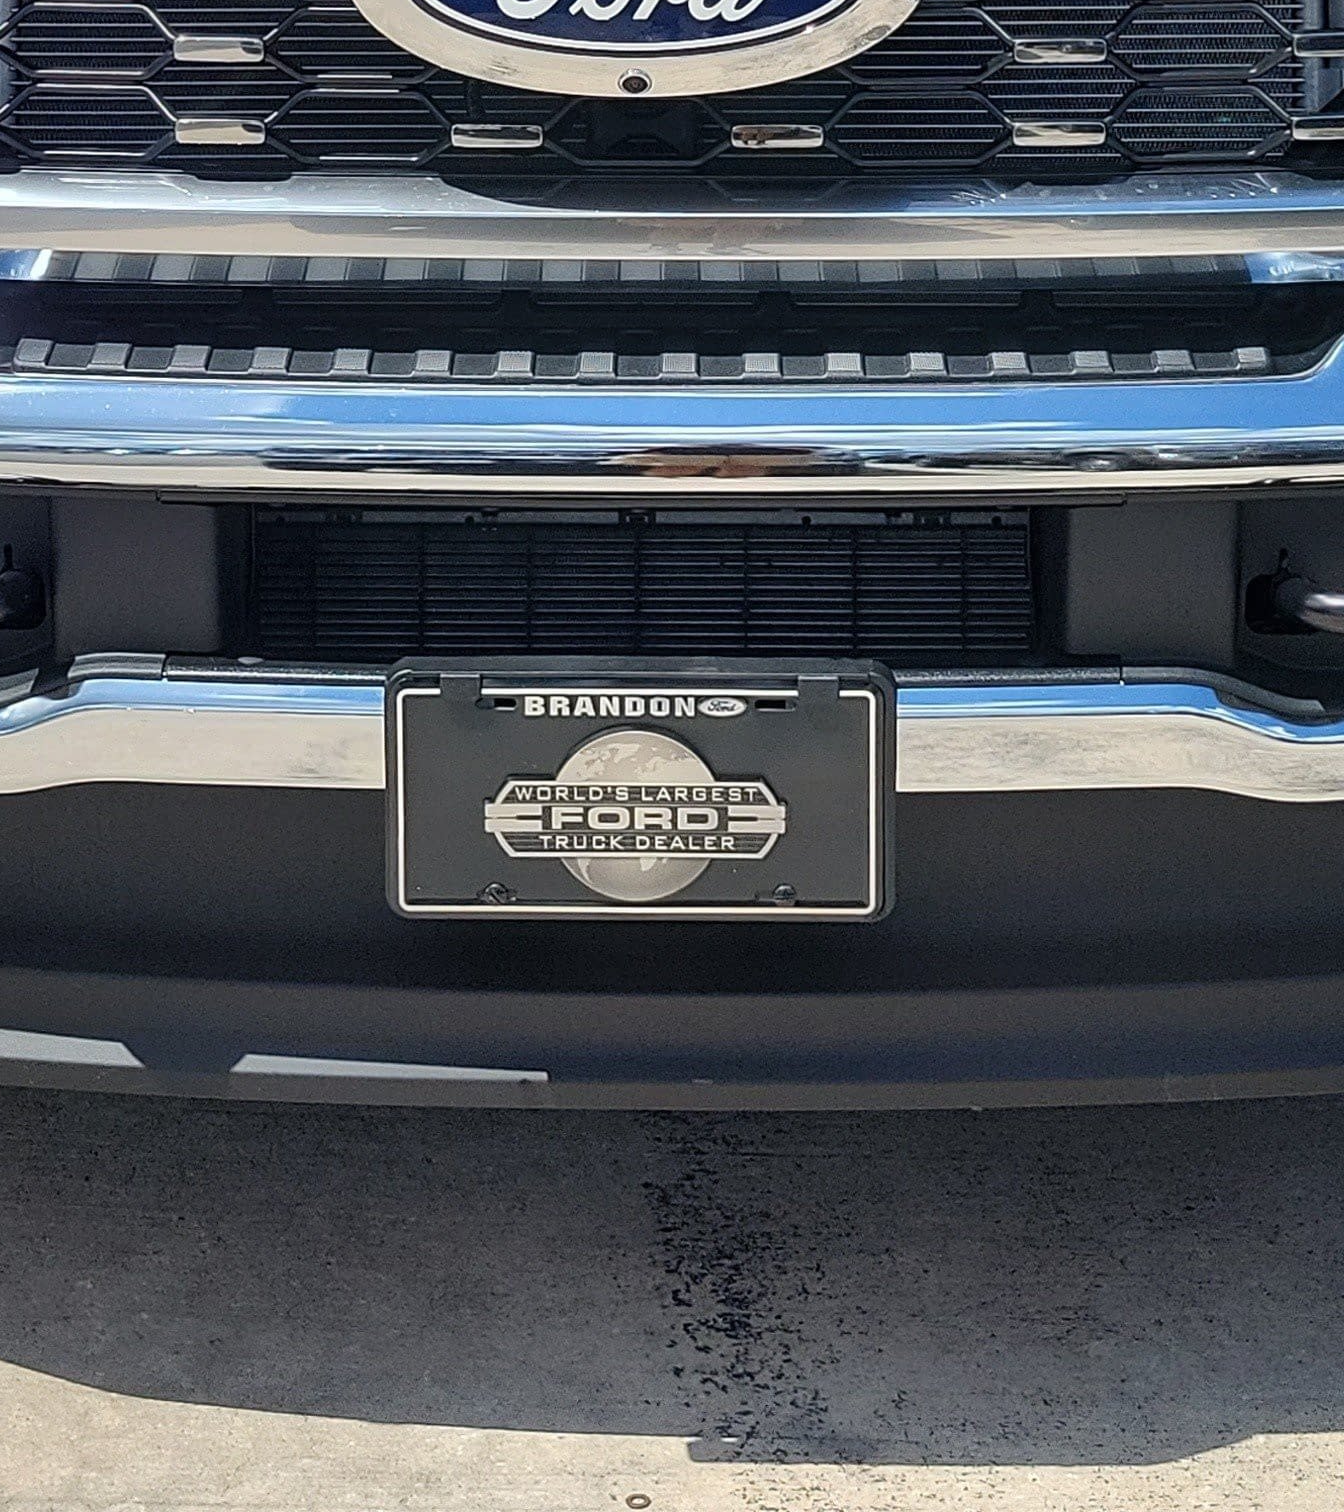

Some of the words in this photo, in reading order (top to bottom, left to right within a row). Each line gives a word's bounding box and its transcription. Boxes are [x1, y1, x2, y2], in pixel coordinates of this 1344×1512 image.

[523, 695, 696, 717] BRANDON
[514, 786, 629, 802] WORLD'S
[640, 787, 758, 803] LARGEST
[550, 806, 719, 831] FORD
[538, 834, 625, 850] TRUCK
[635, 835, 736, 851] DEALER
